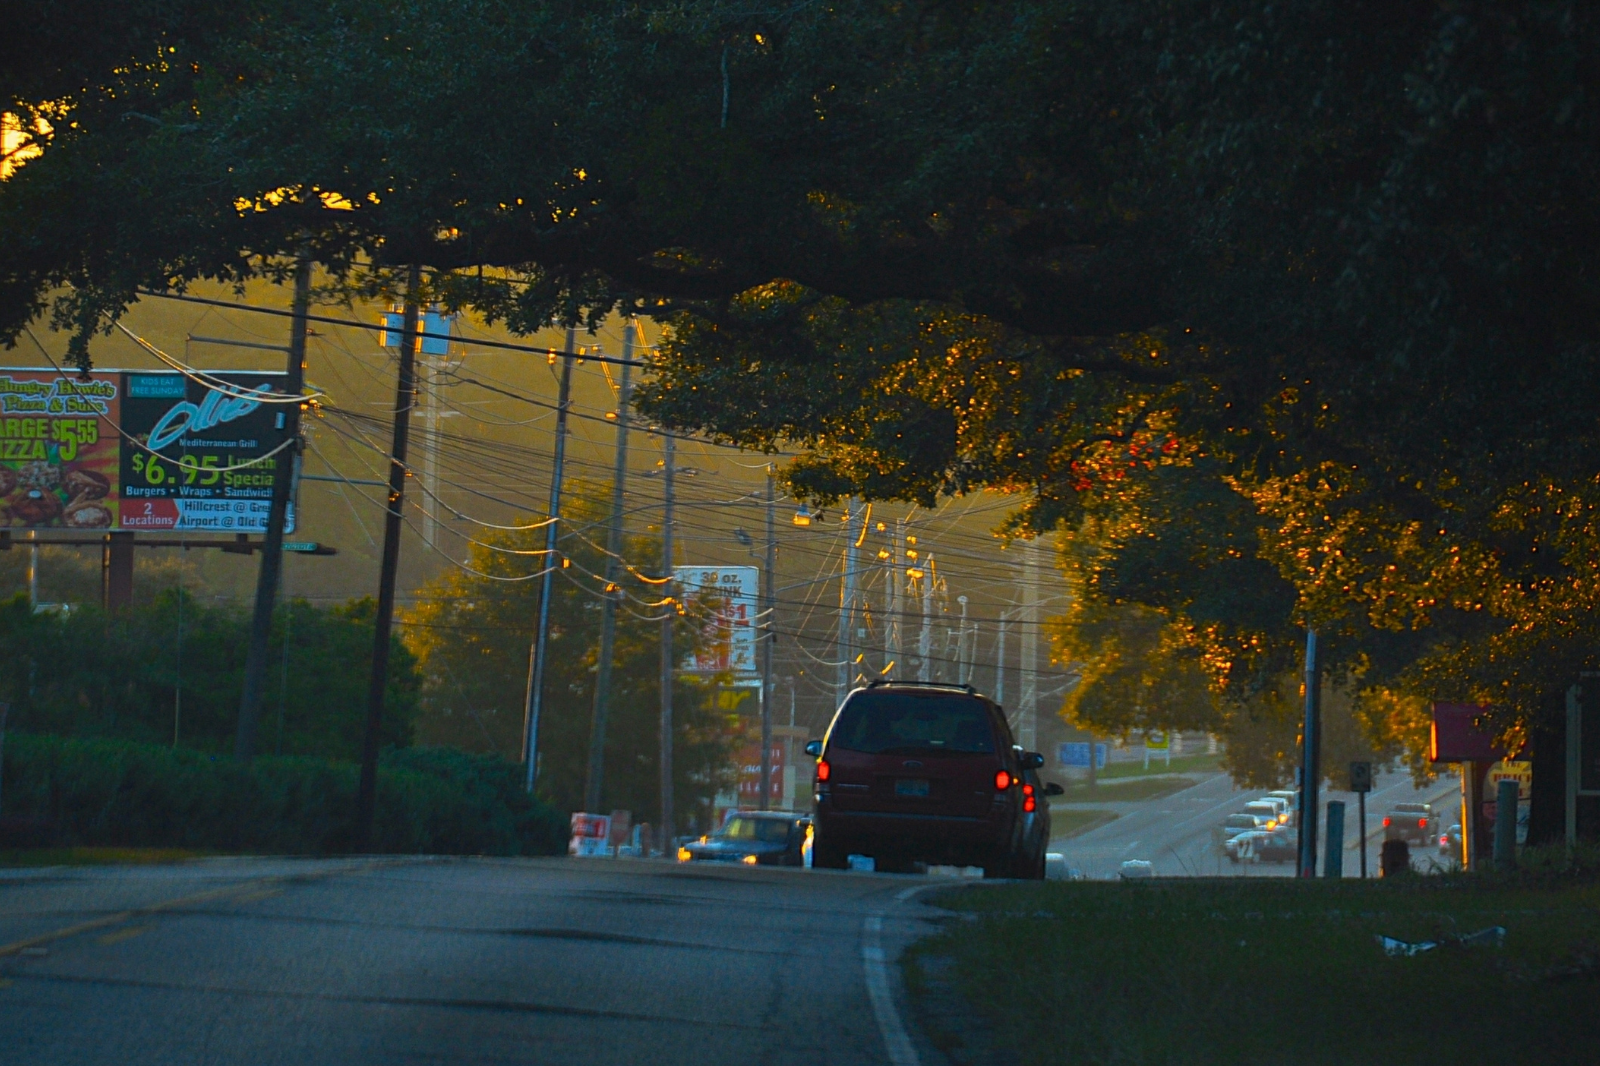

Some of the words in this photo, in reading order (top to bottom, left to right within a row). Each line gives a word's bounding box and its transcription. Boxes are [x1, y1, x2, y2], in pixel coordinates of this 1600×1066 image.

[140, 378, 159, 386] KIDS
[160, 378, 174, 386] EAT
[132, 386, 151, 394] FREE
[152, 386, 185, 394] SUNDAY
[4, 395, 46, 411] Pizza
[49, 398, 63, 412] &
[179, 439, 238, 447] Mediterranean
[132, 452, 220, 485] $6.95
[223, 470, 275, 487] Specia
[126, 486, 166, 498] Burgers
[179, 486, 212, 498] Wraps
[144, 502, 152, 515] 2
[184, 501, 230, 512] Hillcrest
[233, 502, 246, 513] @
[123, 514, 173, 525] Locations
[179, 516, 218, 527] Airport
[221, 517, 233, 527] @
